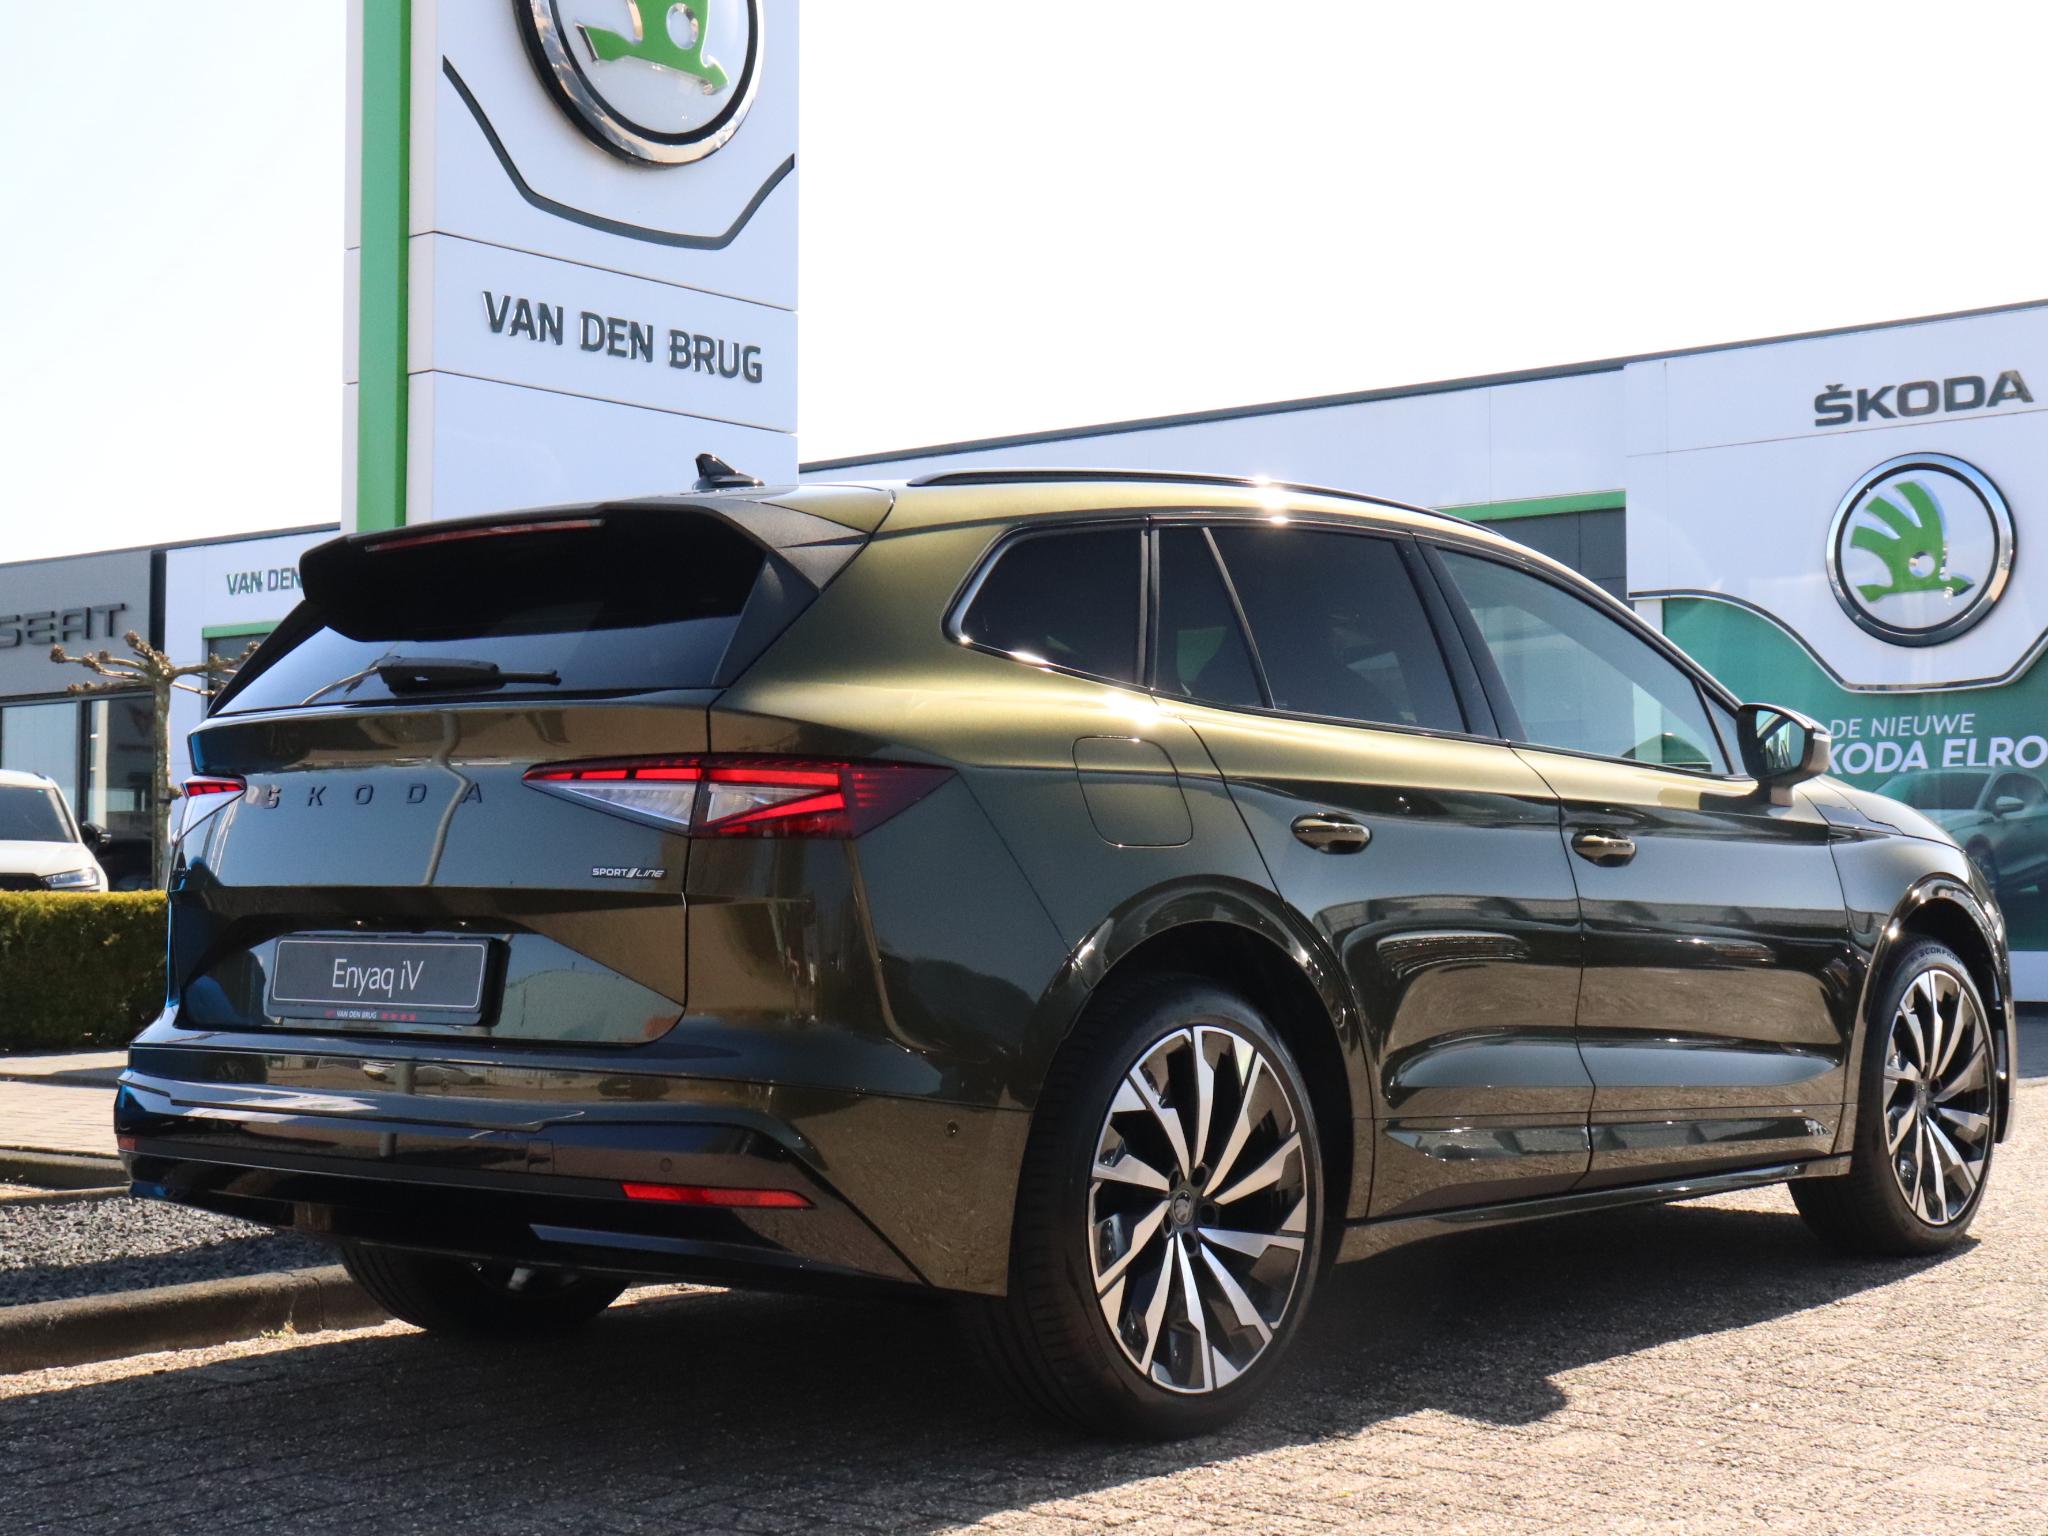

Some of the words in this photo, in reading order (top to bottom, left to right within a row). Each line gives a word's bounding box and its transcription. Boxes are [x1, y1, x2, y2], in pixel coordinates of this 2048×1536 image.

[482, 291, 564, 346] VAN
[580, 311, 654, 363] DEN
[669, 329, 763, 384] BRUG
[1814, 369, 2035, 428] ŠKODA
[226, 570, 263, 596] VAN
[0, 603, 126, 649] SEAT
[1830, 718, 1863, 740] DE
[1870, 713, 1976, 738] NIEUWE
[263, 782, 484, 810] SKODA
[332, 958, 396, 999] Enyaq
[400, 960, 425, 991] iV
